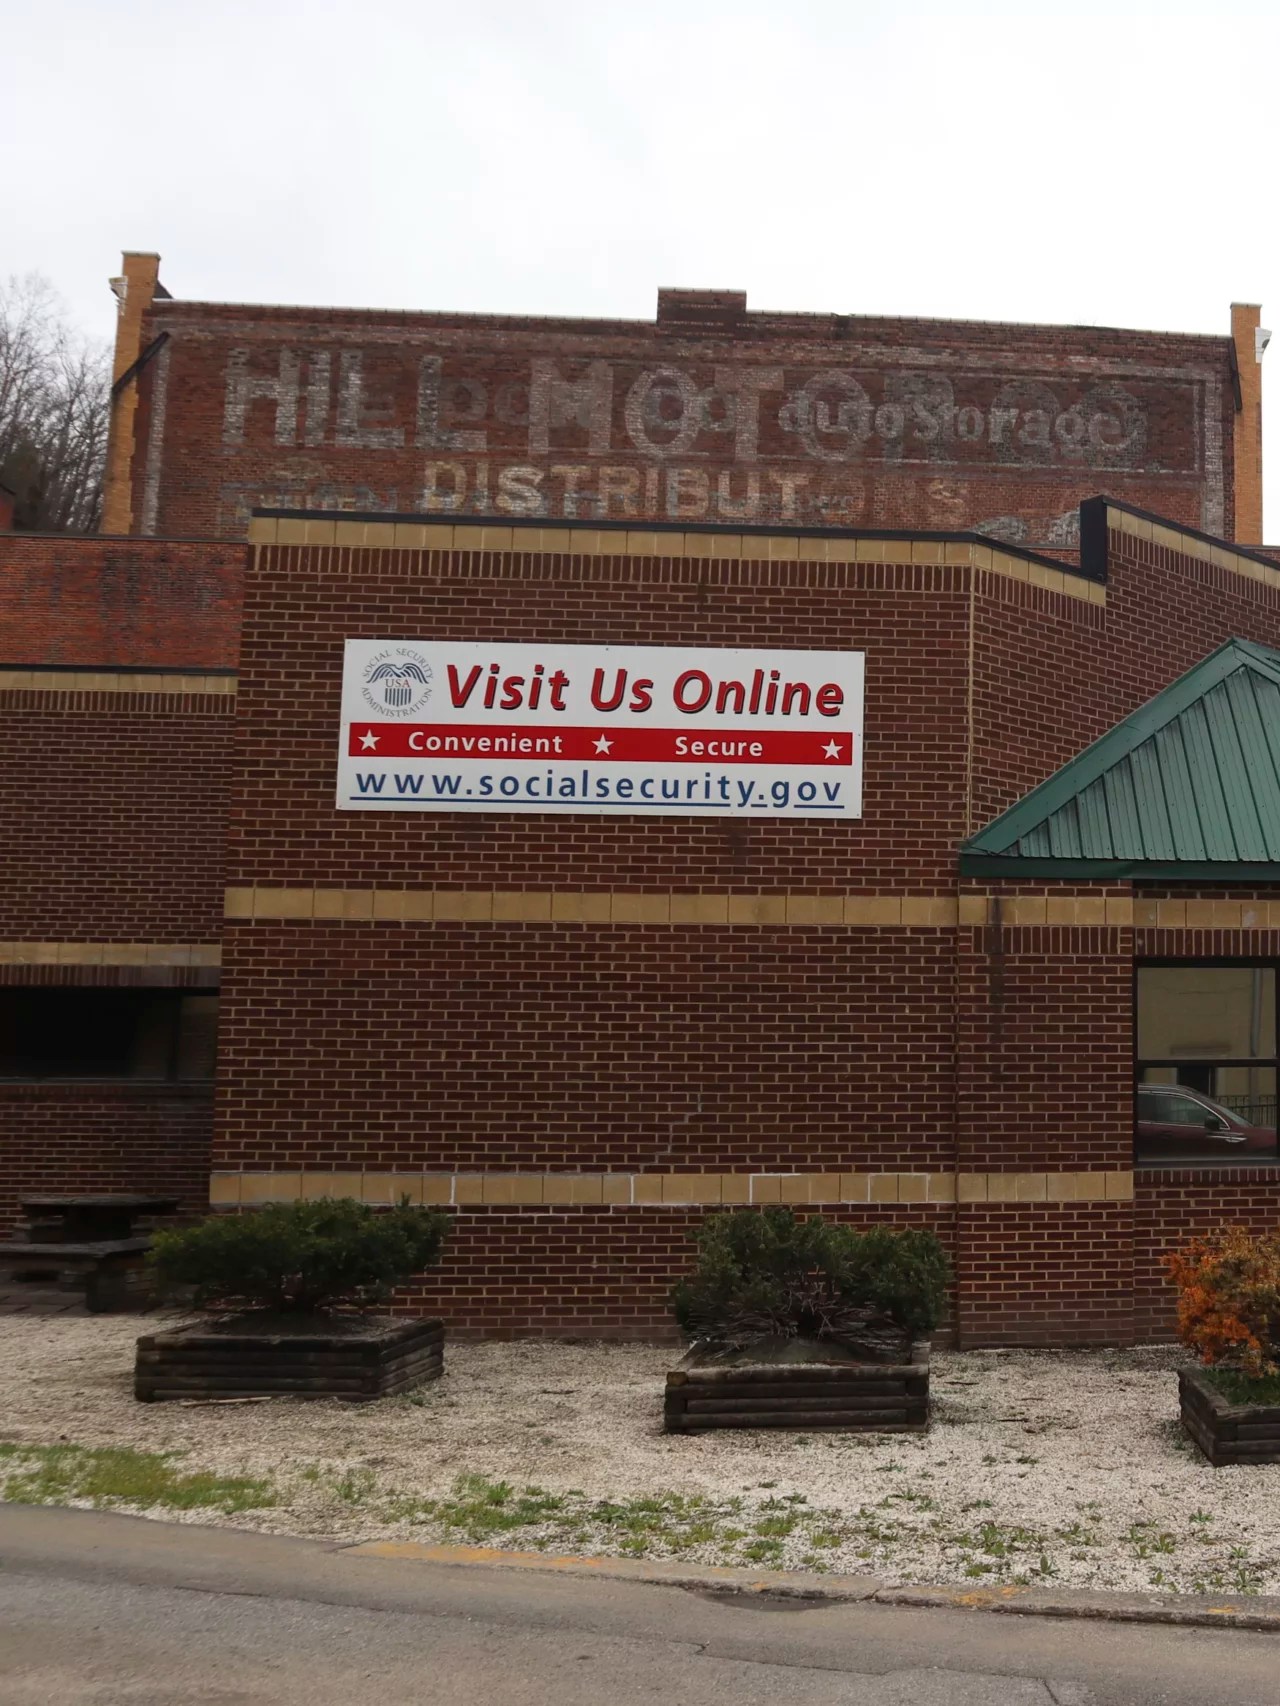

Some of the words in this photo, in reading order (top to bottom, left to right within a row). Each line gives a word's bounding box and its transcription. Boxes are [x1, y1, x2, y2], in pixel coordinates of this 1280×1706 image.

[362, 650, 392, 677] SOCIAL
[396, 647, 434, 679] SECURITY
[385, 678, 411, 688] USA
[446, 664, 570, 711] Visit
[590, 668, 653, 713] Us
[672, 669, 845, 716] Online
[361, 687, 433, 718] ADMINISTRATION
[408, 731, 563, 755] Convenient
[675, 737, 764, 758] Secure
[356, 768, 841, 807] www.socialsecurity.gov
